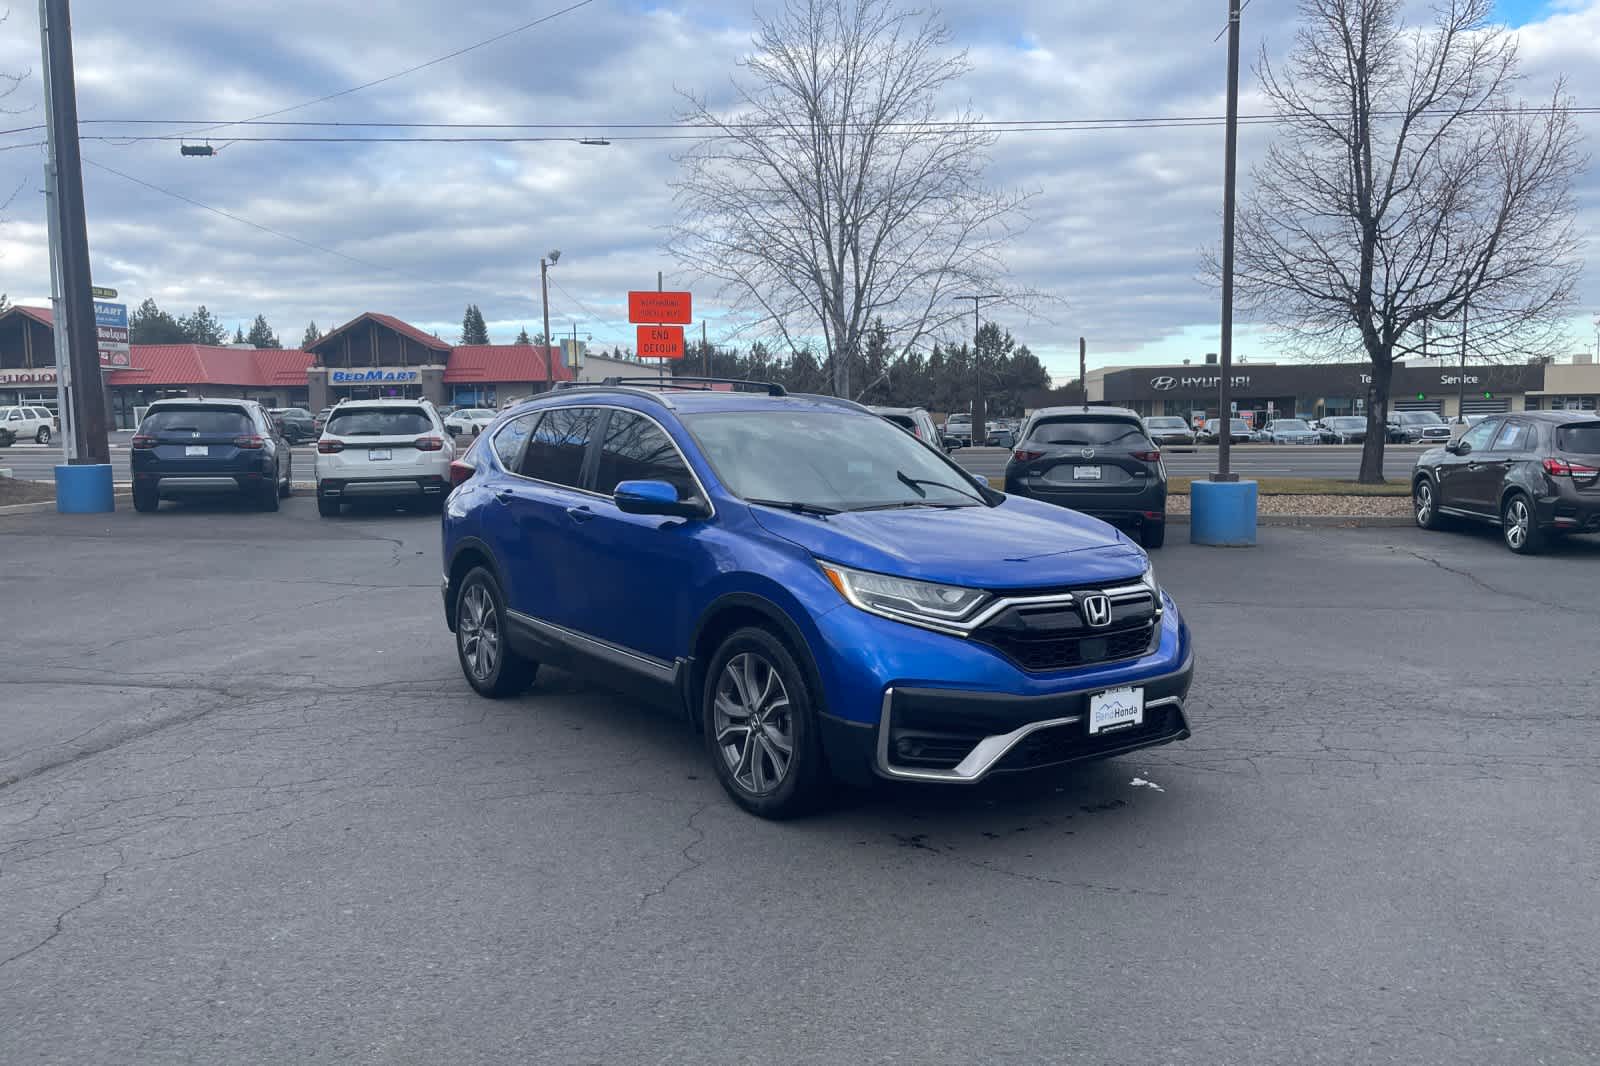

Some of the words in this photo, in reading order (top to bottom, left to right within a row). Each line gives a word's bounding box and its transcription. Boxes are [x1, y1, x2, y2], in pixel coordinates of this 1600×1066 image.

[651, 330, 669, 340] END
[643, 343, 677, 353] DETOUR
[1181, 376, 1250, 388] HYUNAI
